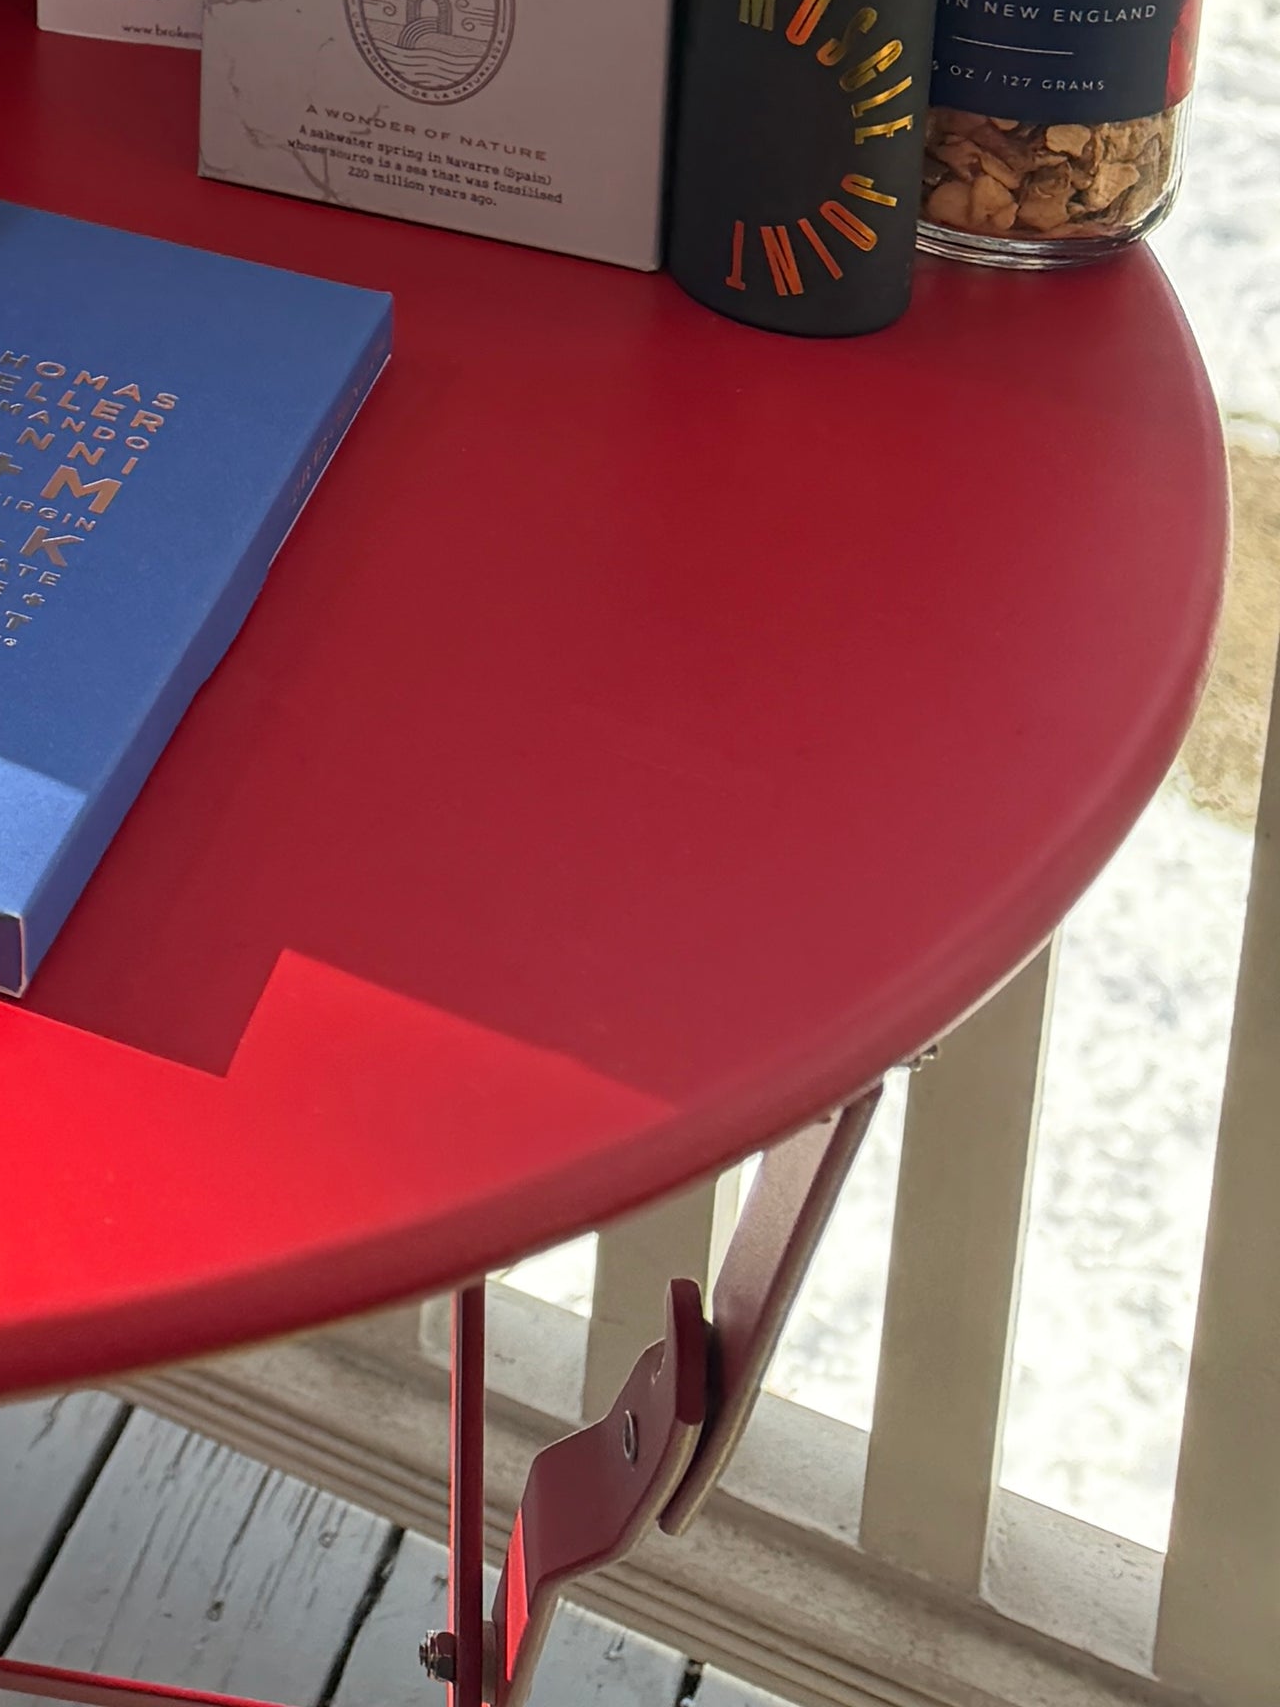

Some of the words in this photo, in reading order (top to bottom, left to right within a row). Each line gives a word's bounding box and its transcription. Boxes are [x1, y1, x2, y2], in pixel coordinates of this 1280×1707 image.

[983, 0, 1040, 19] NEW
[1052, 5, 1157, 23] ENGLAND
[950, 65, 975, 79] OZ
[1002, 75, 1032, 88] 127
[1042, 79, 1105, 91] GRAMS
[298, 124, 307, 136] A
[309, 127, 373, 150] saltwater
[377, 142, 423, 163] spring
[428, 151, 442, 164] in
[445, 154, 500, 176] Navarre
[502, 166, 552, 187] (Spain)
[305, 103, 318, 115] A
[324, 107, 417, 135] WONDER
[423, 128, 451, 140] OF
[459, 135, 548, 162] NATURE
[347, 166, 370, 180] 220
[373, 171, 425, 192] million
[428, 183, 467, 201] years
[469, 192, 497, 207] ago.
[724, 173, 898, 297] JOINT
[40, 464, 123, 515] M
